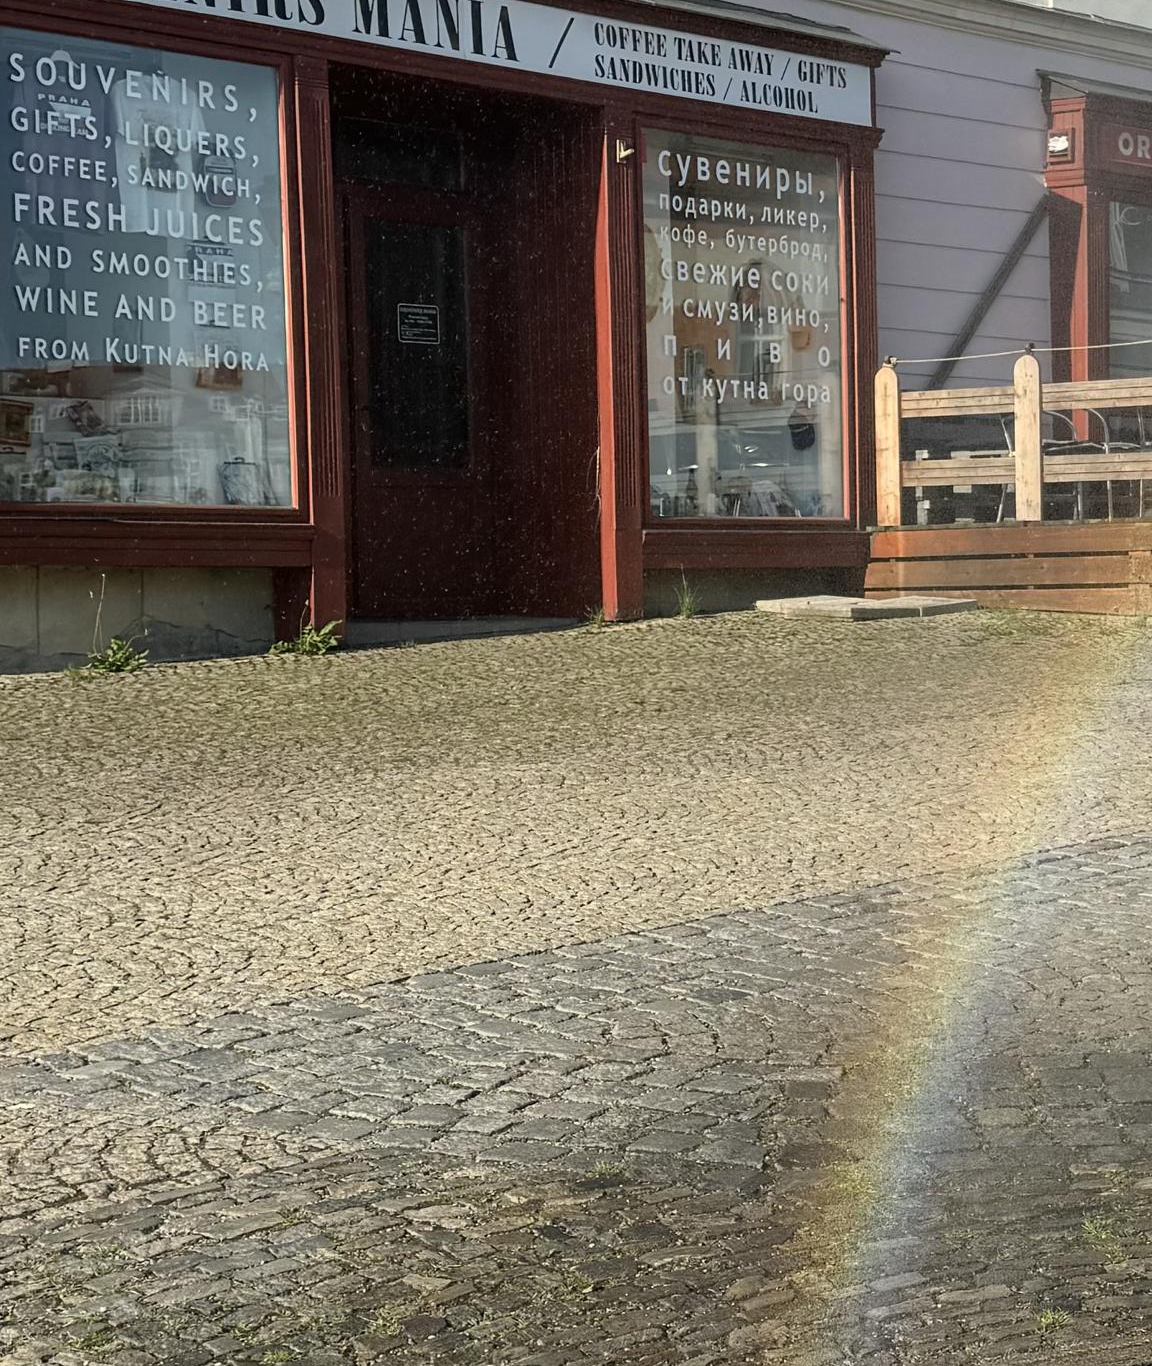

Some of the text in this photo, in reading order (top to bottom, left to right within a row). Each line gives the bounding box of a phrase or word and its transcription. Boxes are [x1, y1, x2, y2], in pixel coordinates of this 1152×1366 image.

[594, 21, 667, 58] COFFEE
[674, 36, 722, 67] TAKE
[728, 47, 774, 77] AWAY
[797, 60, 847, 89] GIFTS
[9, 53, 257, 122] SOUVENIRS,
[37, 93, 90, 106] PRAHA
[594, 53, 716, 97] SANDWICHES
[740, 80, 818, 114] ALCOHOL
[11, 106, 259, 167] GIFTS, LIQUERS,
[12, 151, 261, 204] COFFEE, SANDWICH,
[658, 149, 825, 203] сувениры,
[14, 192, 263, 246] FRESH JUICES
[659, 193, 827, 234] подарки, ликер,
[660, 224, 714, 250] кофе,
[14, 243, 263, 293] AND SMOOTHIES,
[661, 258, 829, 295] свежие соки
[15, 285, 267, 330] WINE AND BEER
[18, 337, 269, 372] FROM KUTNA HORA
[663, 376, 831, 408] от кутна гора
